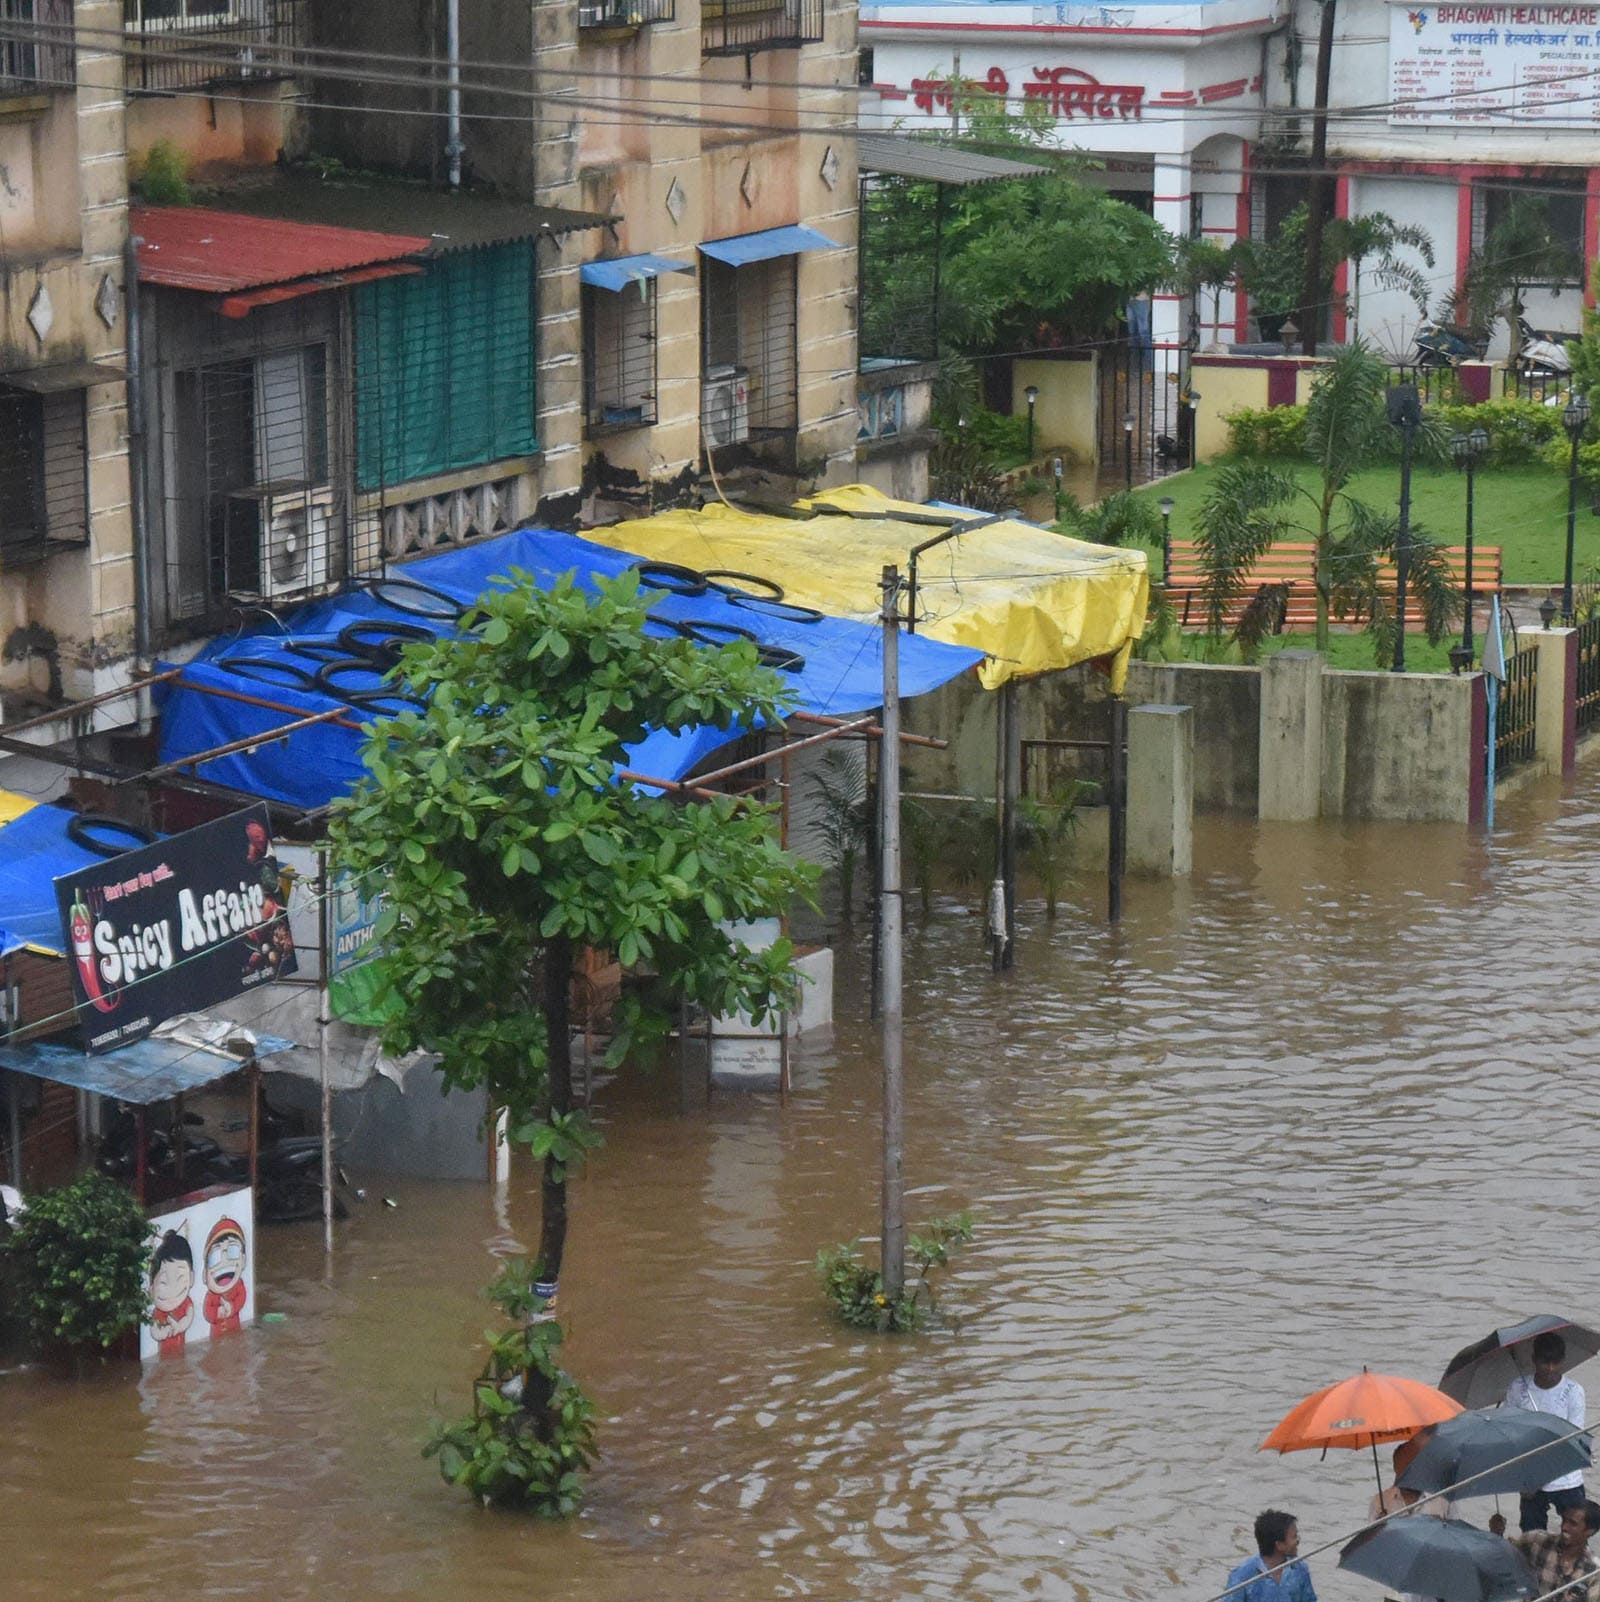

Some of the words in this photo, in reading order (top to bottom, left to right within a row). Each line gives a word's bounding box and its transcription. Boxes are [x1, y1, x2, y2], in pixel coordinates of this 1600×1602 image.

[1437, 7, 1506, 25] BHAGWATI
[1510, 7, 1597, 25] HEALTHCARE
[1450, 28, 1498, 46] भगवती
[94, 919, 174, 984] Spicy
[178, 881, 264, 951] Affair
